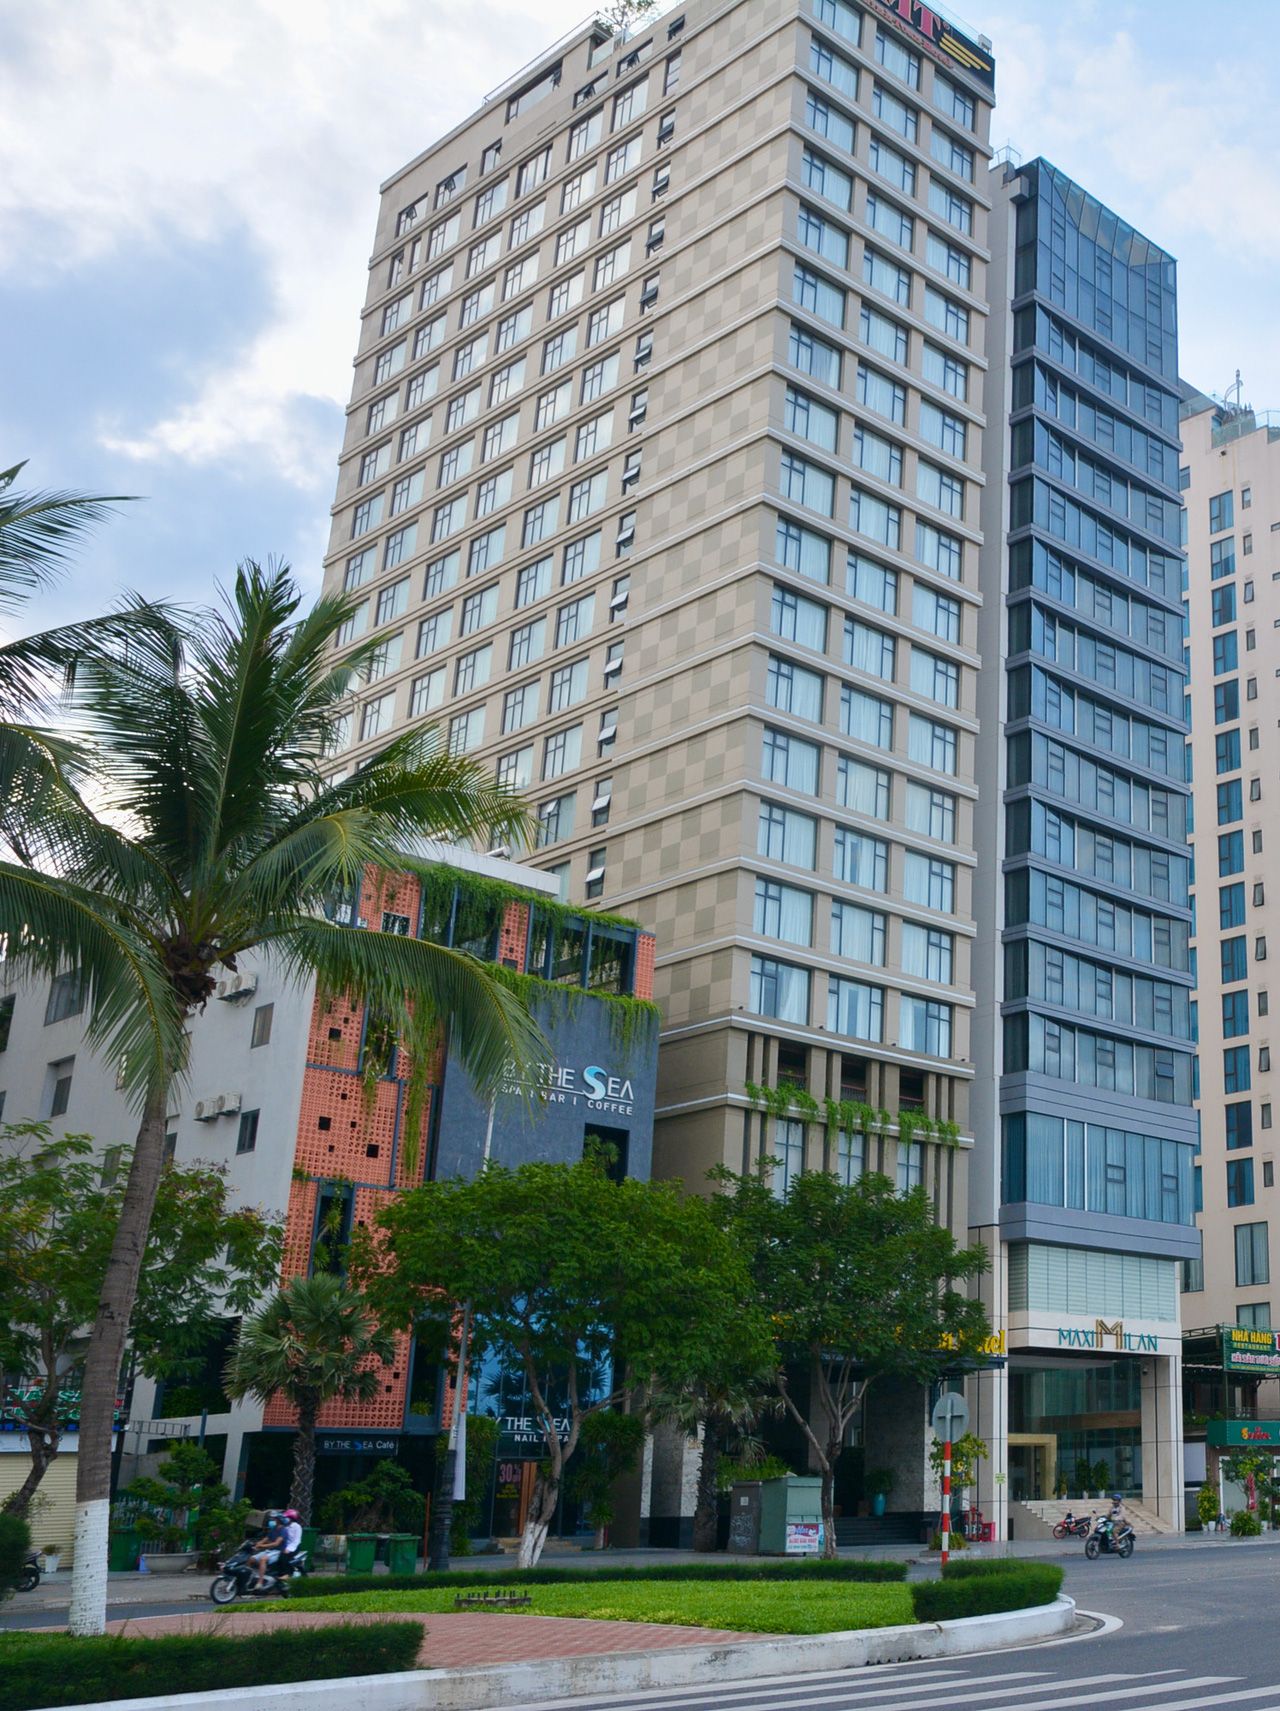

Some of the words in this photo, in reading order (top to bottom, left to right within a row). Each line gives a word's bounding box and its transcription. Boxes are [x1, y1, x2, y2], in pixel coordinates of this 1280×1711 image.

[535, 1061, 576, 1090] THE
[582, 1065, 634, 1101] SEA
[587, 1099, 634, 1117] COFFEE
[505, 1416, 533, 1431] THE
[323, 1440, 335, 1449] BY
[336, 1440, 352, 1449] THE
[514, 1434, 538, 1442] NAIL
